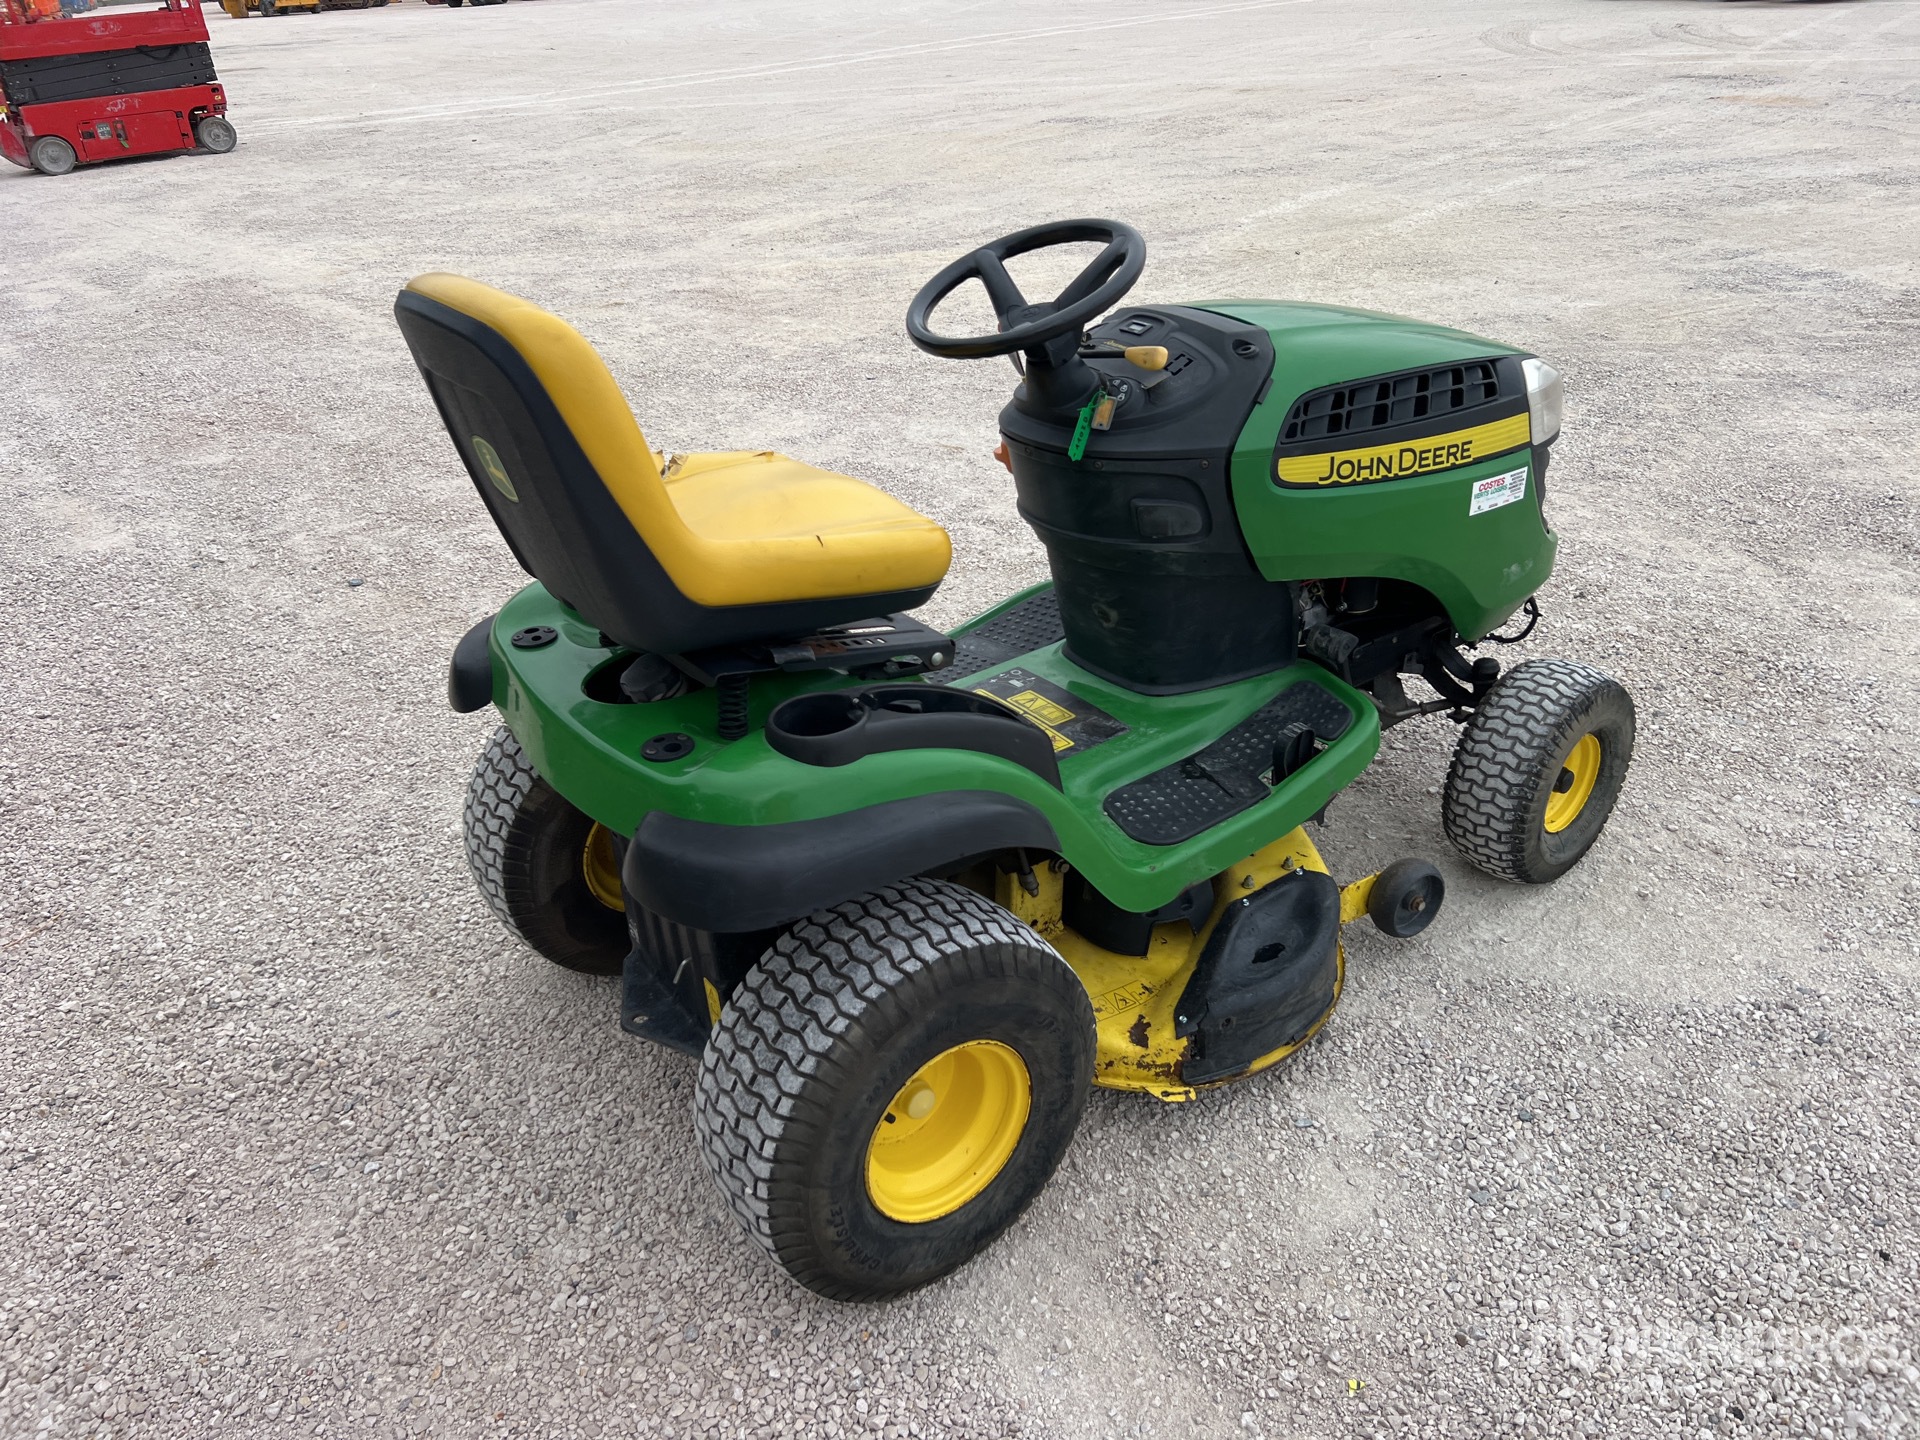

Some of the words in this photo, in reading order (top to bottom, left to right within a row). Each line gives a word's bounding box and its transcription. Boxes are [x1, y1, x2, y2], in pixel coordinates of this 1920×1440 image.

[1318, 454, 1393, 483] JOHN
[1398, 440, 1473, 474] DEERE
[1478, 476, 1506, 492] COSTES
